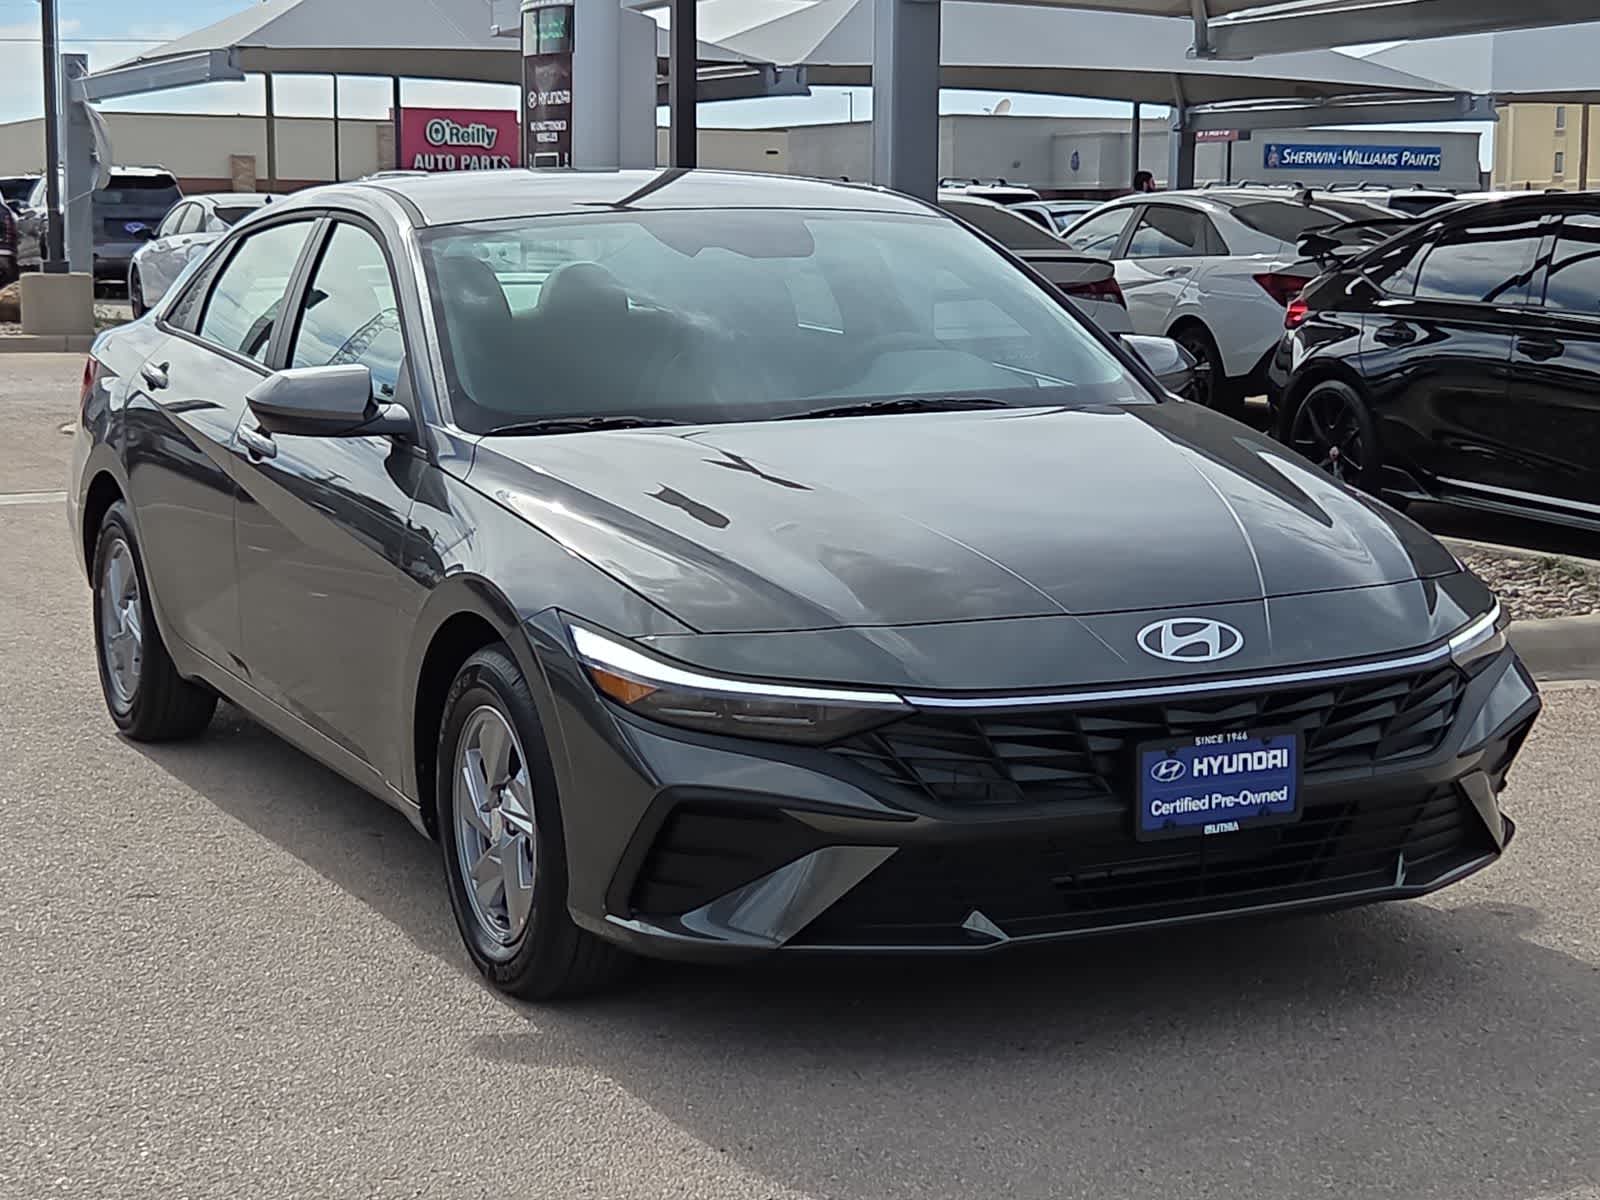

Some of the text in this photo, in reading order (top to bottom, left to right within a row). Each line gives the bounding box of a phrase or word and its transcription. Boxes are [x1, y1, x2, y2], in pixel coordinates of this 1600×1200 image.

[427, 119, 497, 149] O'Reilly
[413, 153, 511, 171] AUTO PARTS
[1281, 148, 1440, 166] SHERWIN-WILLIAMS PAINTS
[1195, 733, 1223, 746] SINCE
[1193, 748, 1287, 777] HYUNDAI
[1151, 785, 1288, 816] Certified Pre-Owned
